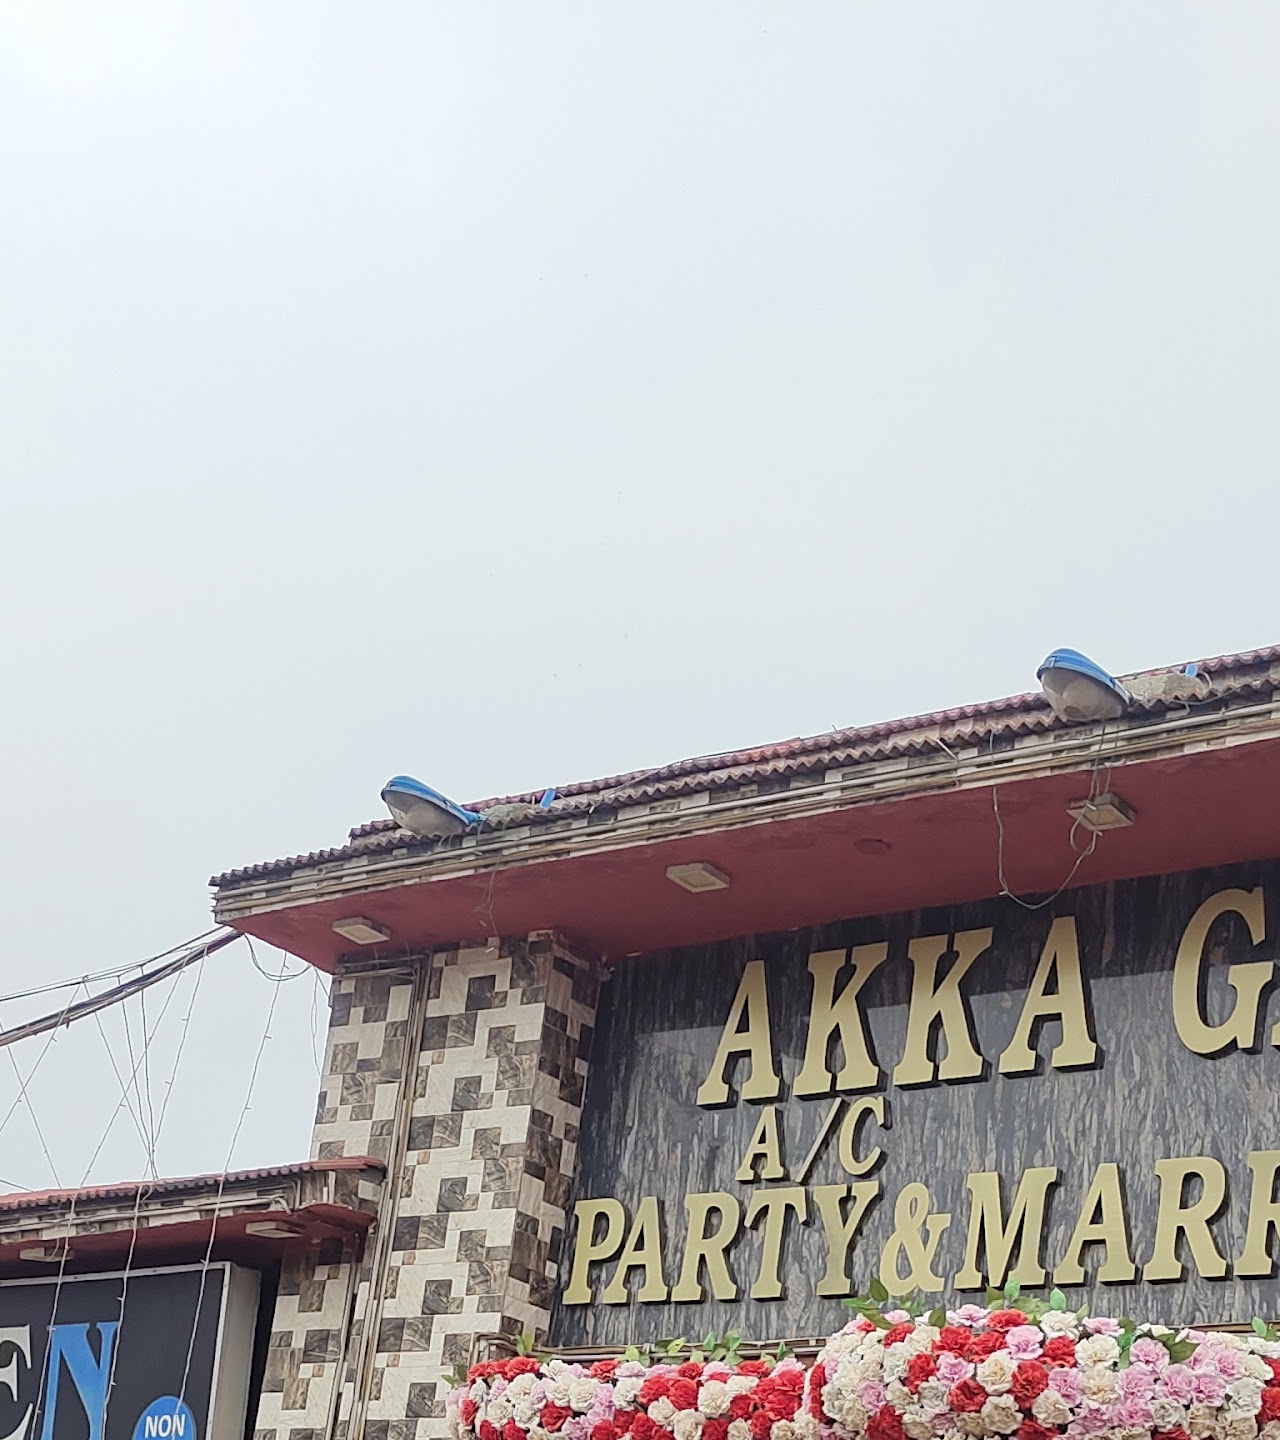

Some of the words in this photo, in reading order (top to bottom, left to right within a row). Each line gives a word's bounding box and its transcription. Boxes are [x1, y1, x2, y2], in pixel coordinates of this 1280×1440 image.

[696, 915, 1099, 1107] AKKA
[734, 1096, 886, 1183] A/C
[144, 1413, 186, 1439] NON
